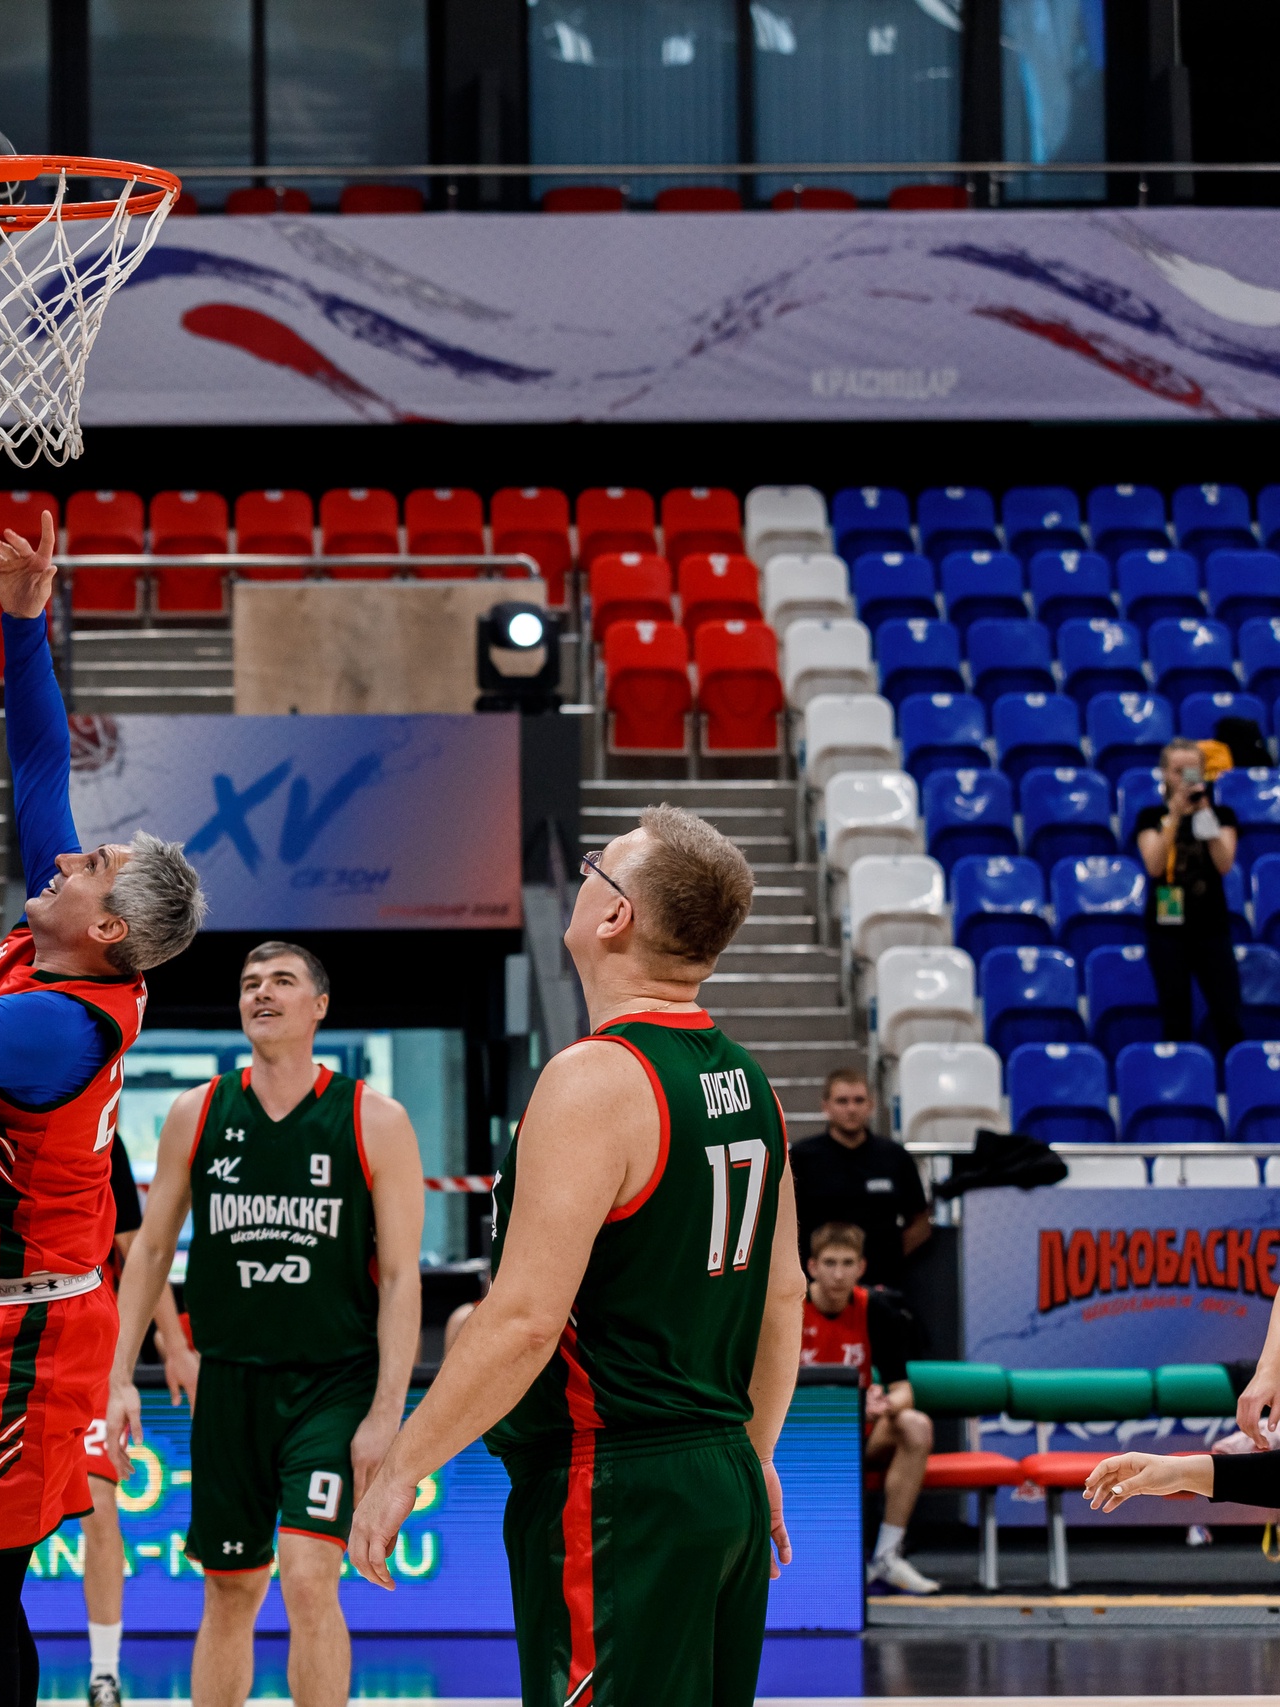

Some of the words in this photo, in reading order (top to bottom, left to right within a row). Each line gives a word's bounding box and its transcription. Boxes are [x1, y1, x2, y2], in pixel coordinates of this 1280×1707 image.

[185, 751, 384, 877] XV
[699, 1068, 751, 1119] ДУБКО
[310, 1154, 331, 1187] 9
[705, 1139, 769, 1276] 17
[307, 1471, 342, 1522] 9
